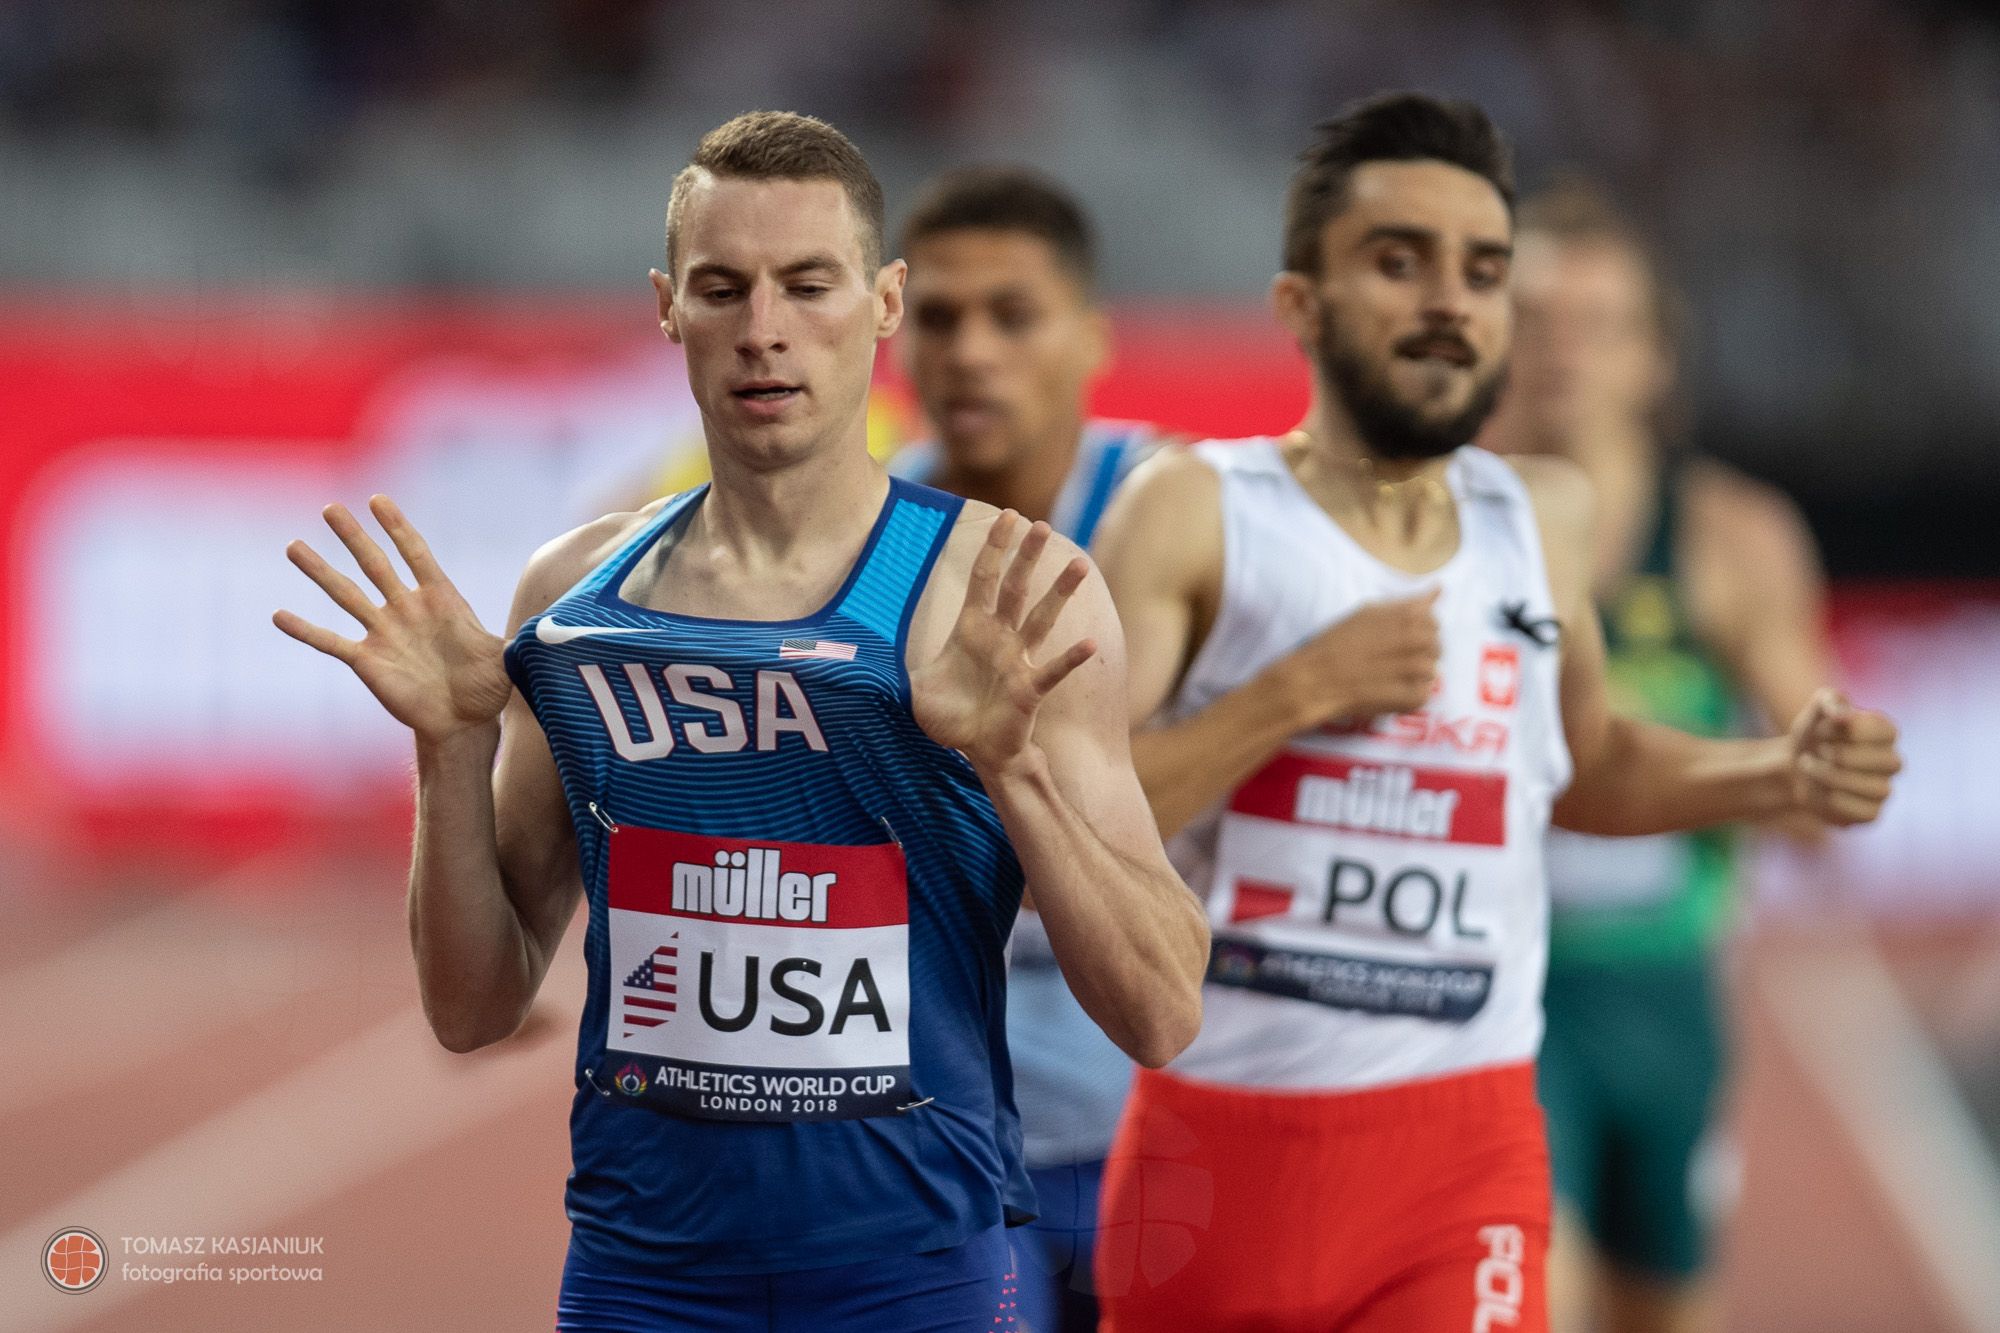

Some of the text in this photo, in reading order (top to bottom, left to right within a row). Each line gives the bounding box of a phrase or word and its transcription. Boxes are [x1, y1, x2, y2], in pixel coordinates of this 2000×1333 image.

[577, 663, 829, 762] USA
[1292, 765, 1461, 840] müller
[670, 846, 837, 923] müller
[1320, 855, 1488, 940] POL
[699, 950, 892, 1037] USA
[655, 1066, 896, 1096] ATHLETICS WORLD CUP
[700, 1095, 838, 1113] LONDON 2018
